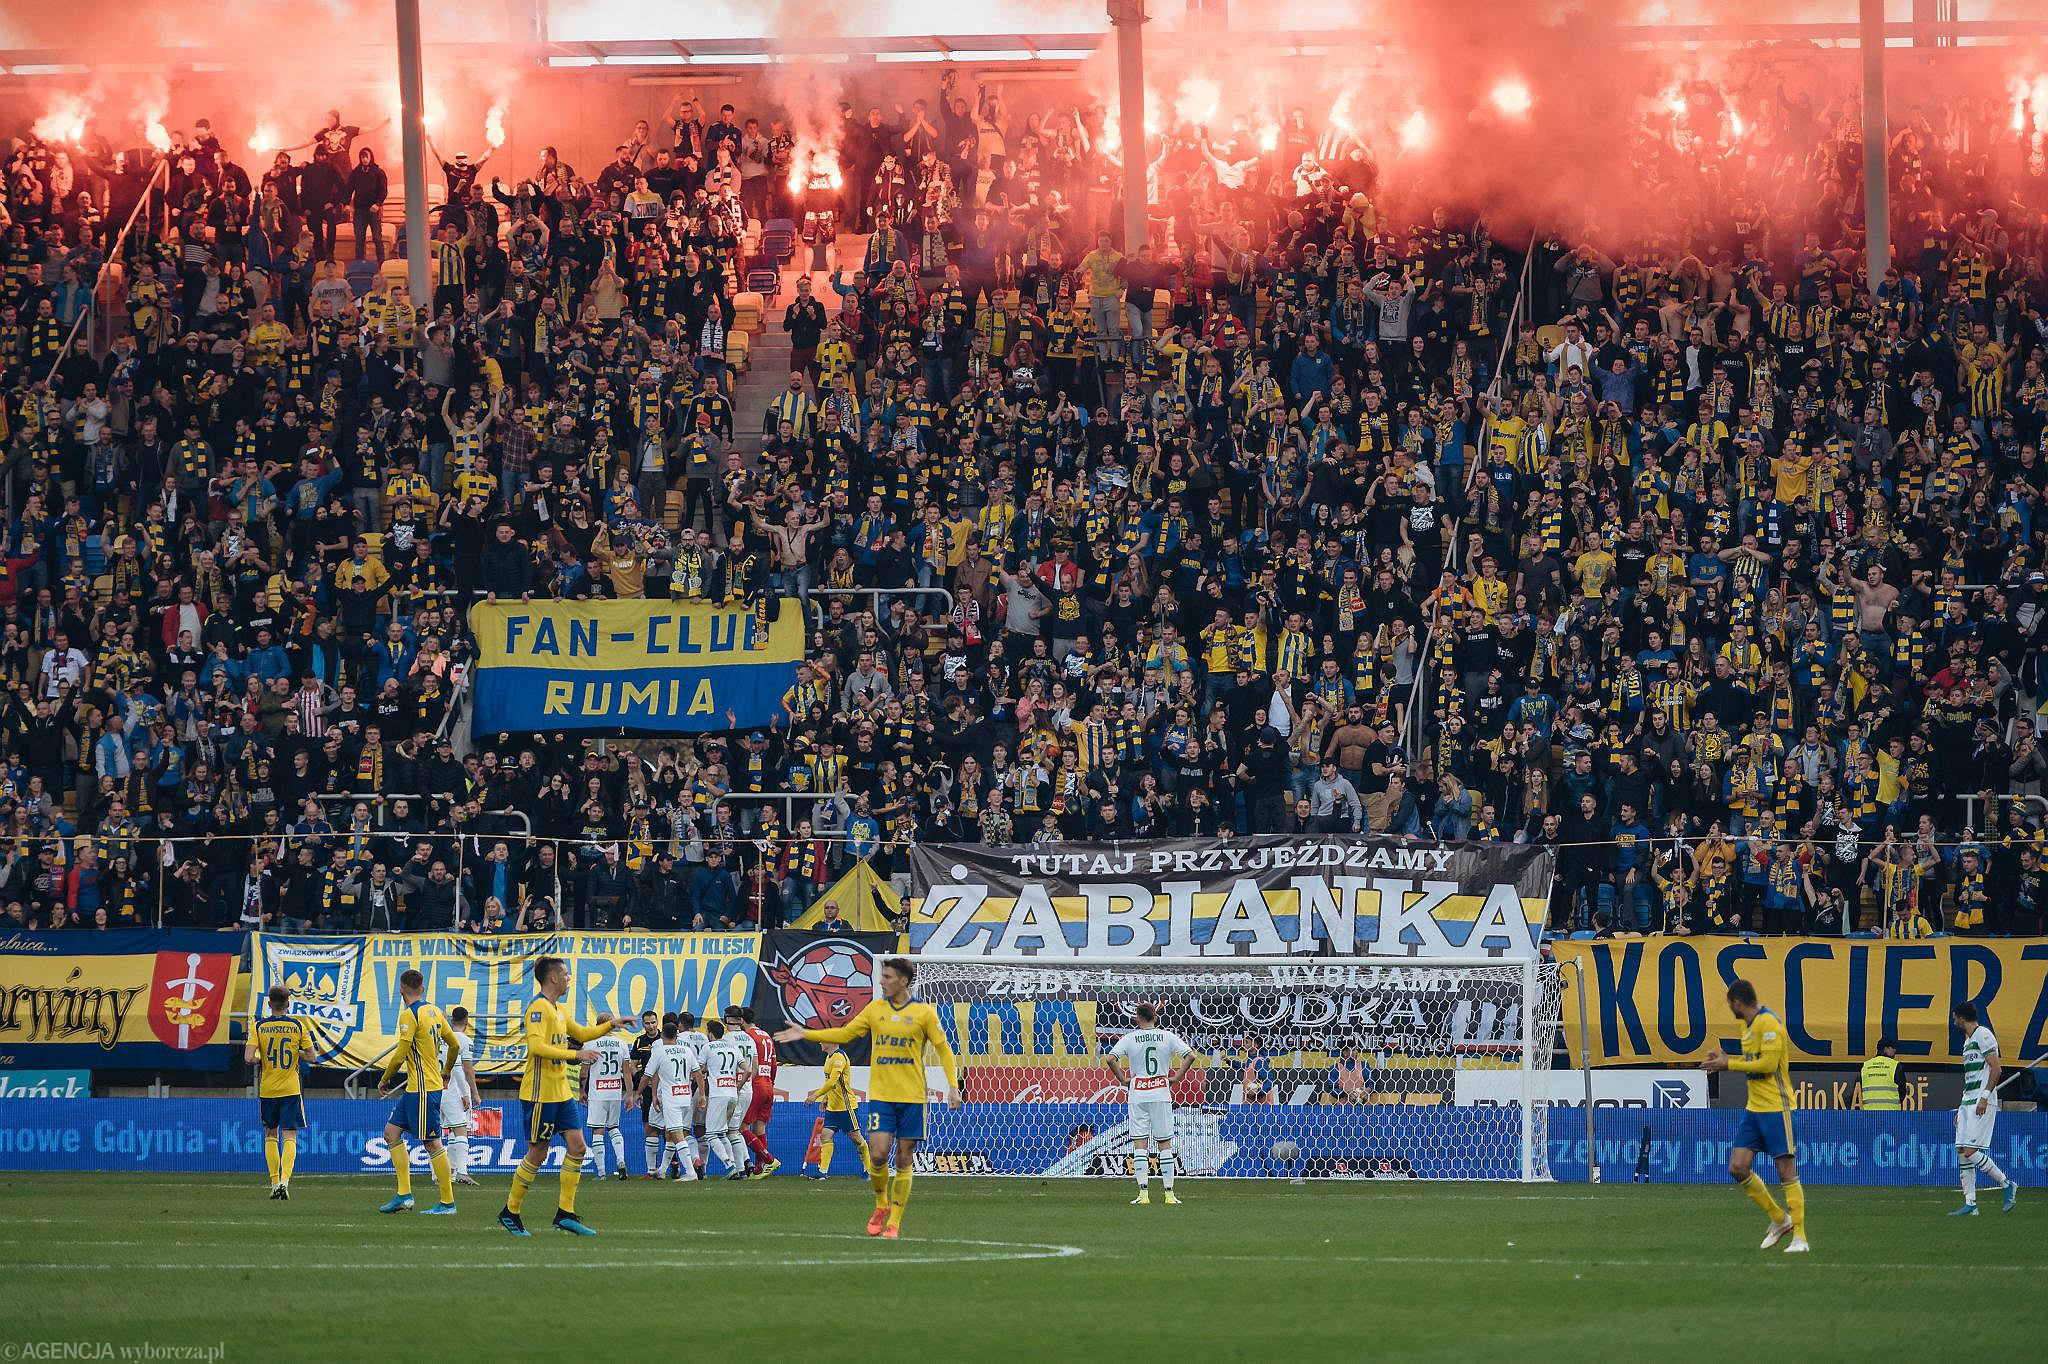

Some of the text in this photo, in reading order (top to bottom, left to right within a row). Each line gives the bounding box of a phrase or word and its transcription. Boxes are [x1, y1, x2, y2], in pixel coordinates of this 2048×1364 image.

[543, 678, 715, 716] RUMIA
[1012, 840, 1455, 876] TUTAJ PRZYJEŻDŻAMY
[918, 863, 1541, 958] ŻABIANKA
[373, 939, 413, 956] LATA
[420, 938, 468, 956] WALK
[580, 936, 684, 956] ZWYCIĘSTW
[690, 937, 695, 954] I
[702, 937, 754, 957] KLĘSK
[266, 1036, 293, 1070] 46
[600, 1051, 620, 1076] 35
[717, 1051, 736, 1075] 22
[1145, 1046, 1158, 1076] 6
[1137, 1077, 1167, 1090] Betclic
